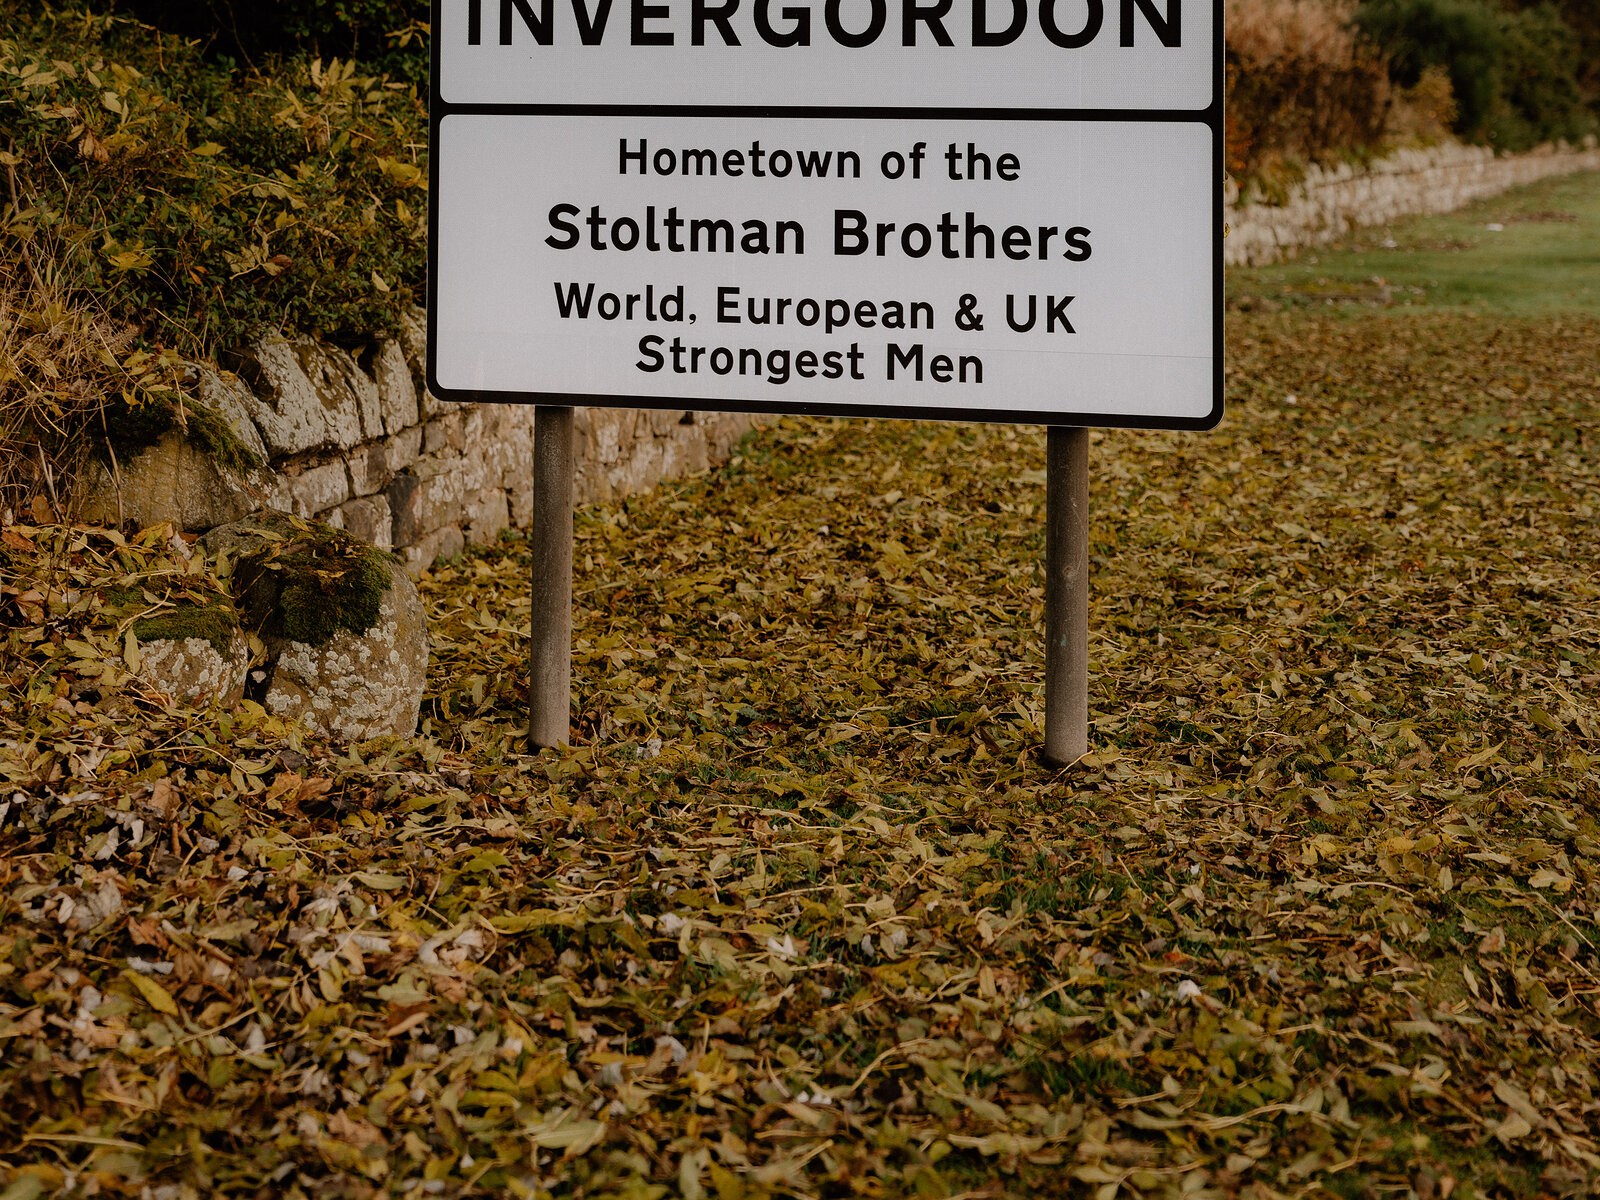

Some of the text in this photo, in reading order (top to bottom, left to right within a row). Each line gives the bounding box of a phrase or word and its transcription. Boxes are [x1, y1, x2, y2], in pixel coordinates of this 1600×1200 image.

[619, 138, 1021, 182] Hometown of the
[544, 202, 1093, 262] Stoltman Brothers
[553, 281, 1077, 335] World, European & UK
[635, 334, 983, 385] Strongest Men
